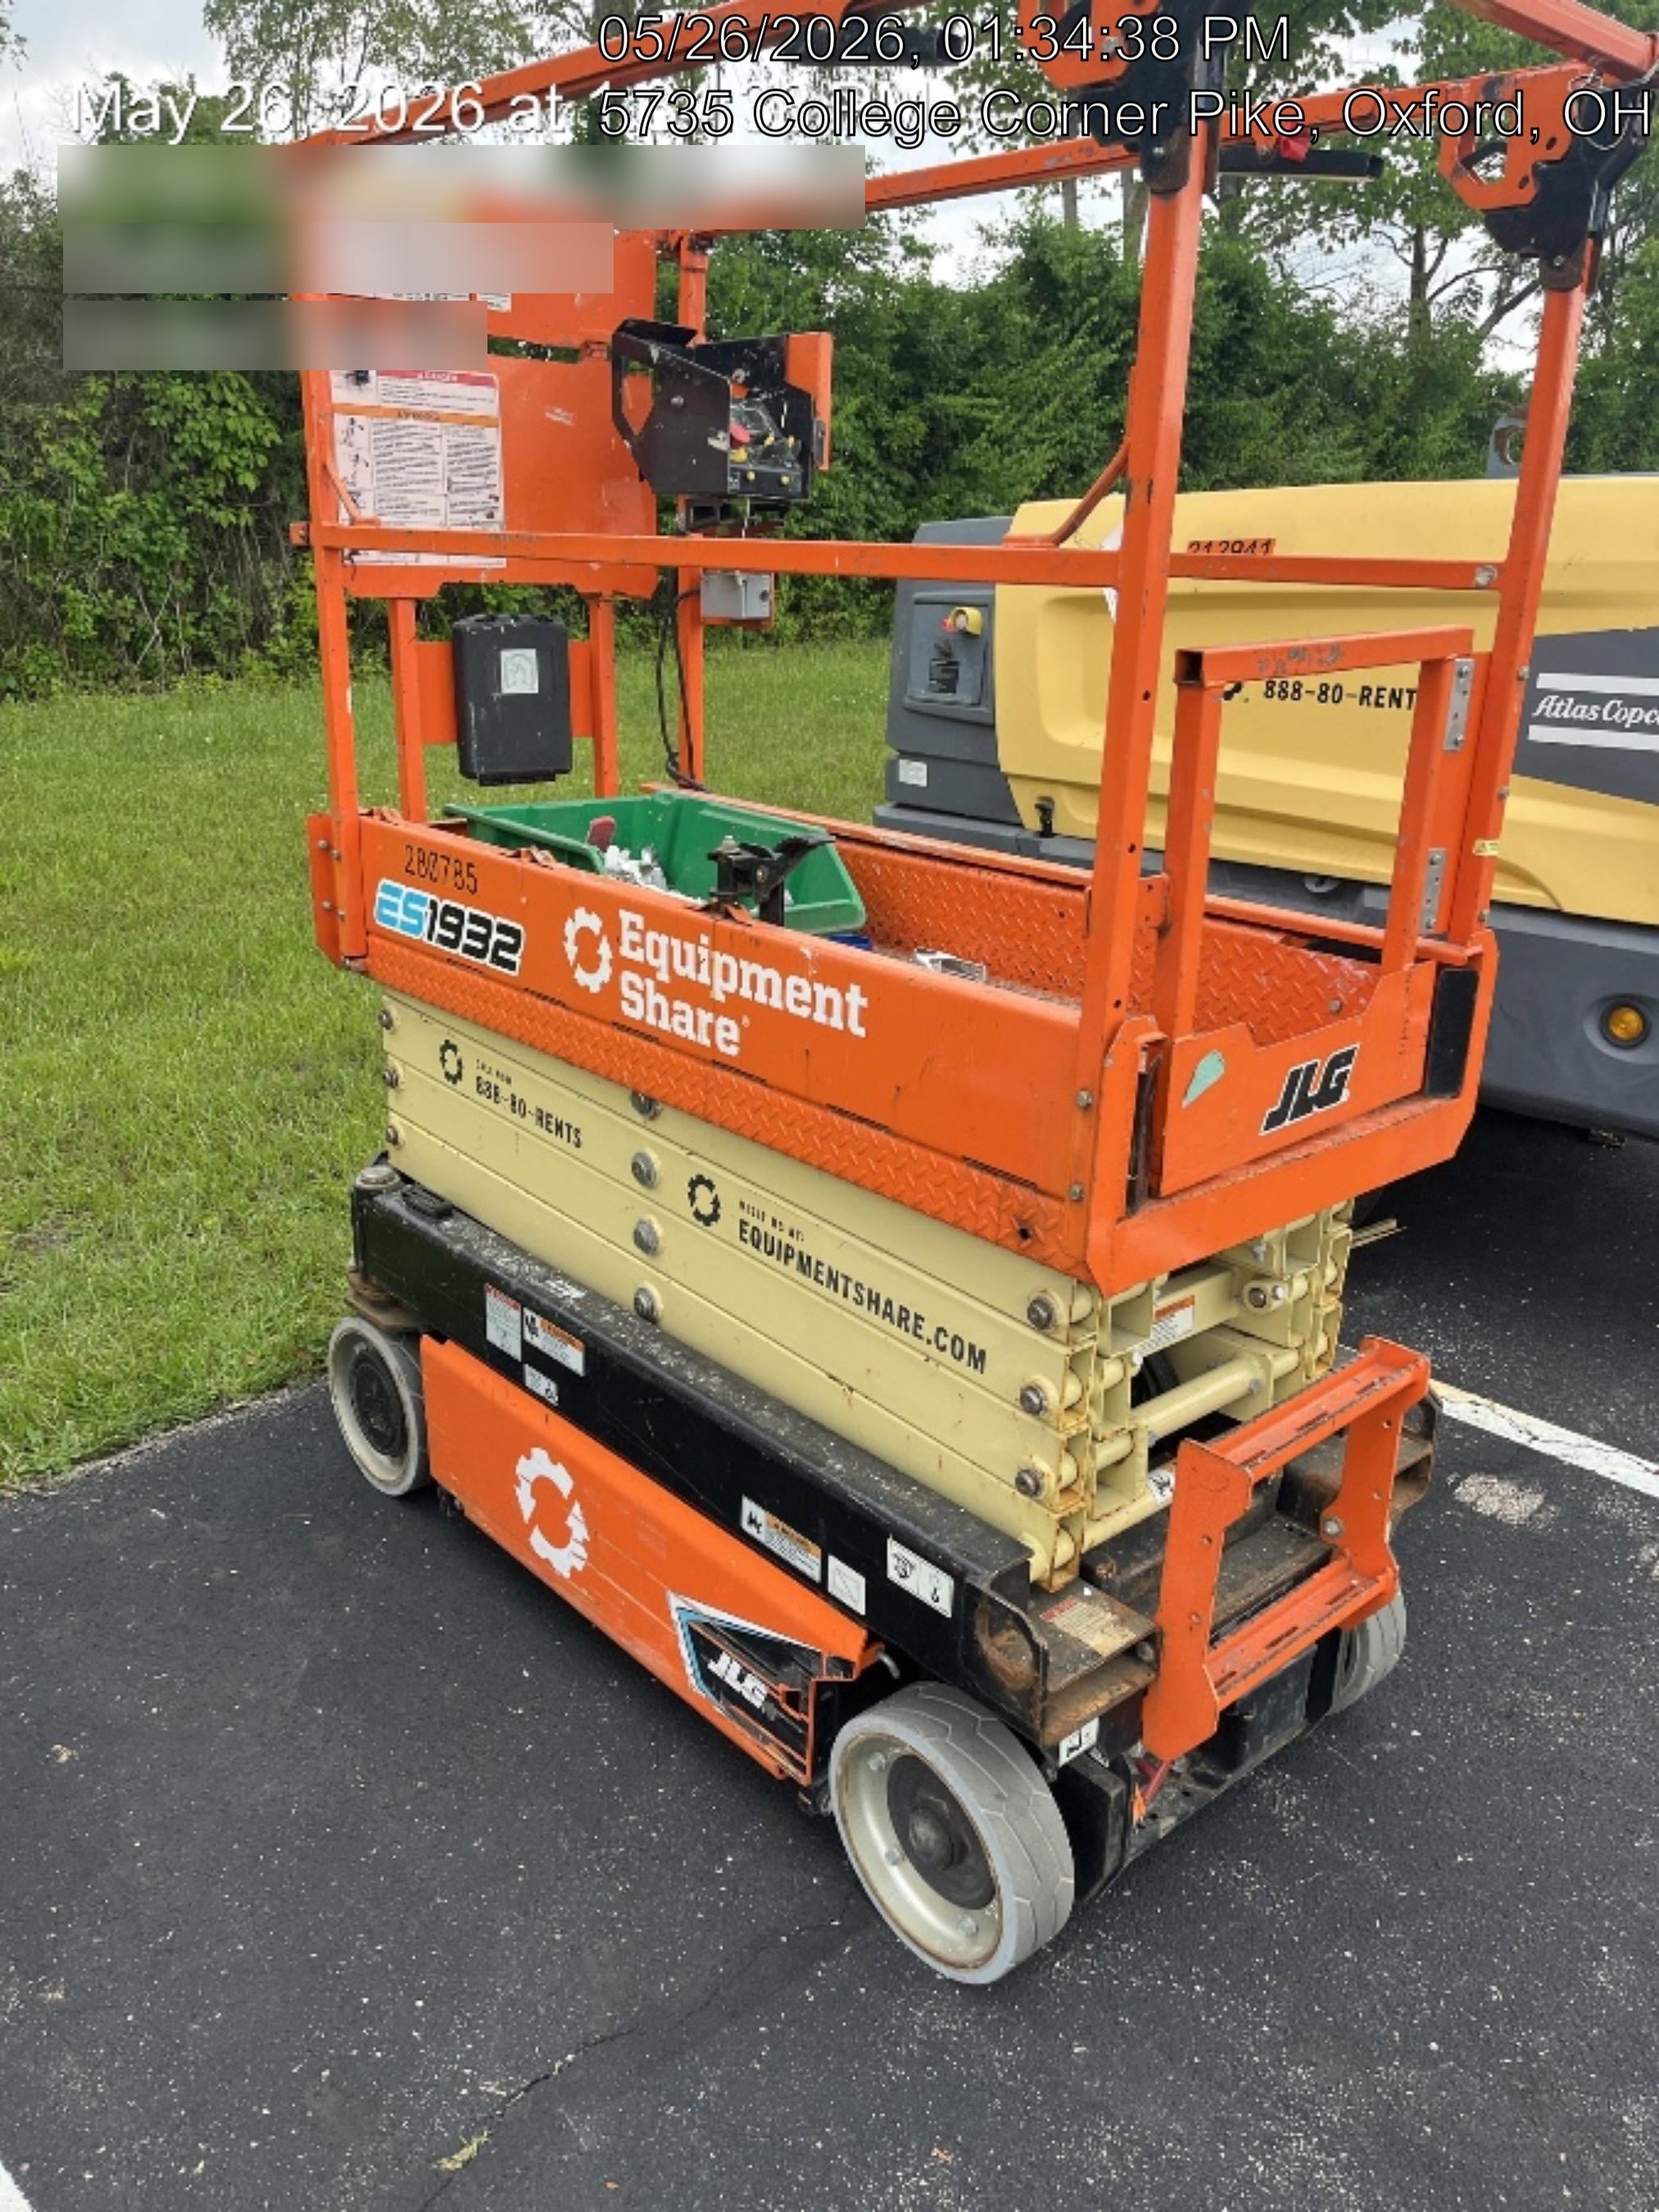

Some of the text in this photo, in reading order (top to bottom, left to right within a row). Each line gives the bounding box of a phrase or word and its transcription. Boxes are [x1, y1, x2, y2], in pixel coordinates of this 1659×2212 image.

[1264, 680, 1416, 710] 888-80-RENT
[1531, 696, 1601, 721] Atlas
[374, 878, 525, 975] ES1932
[618, 909, 868, 1038] Equipment
[1259, 1042, 1361, 1135] JLG
[738, 1218, 986, 1375] EQUIPMENTSHARE.COM
